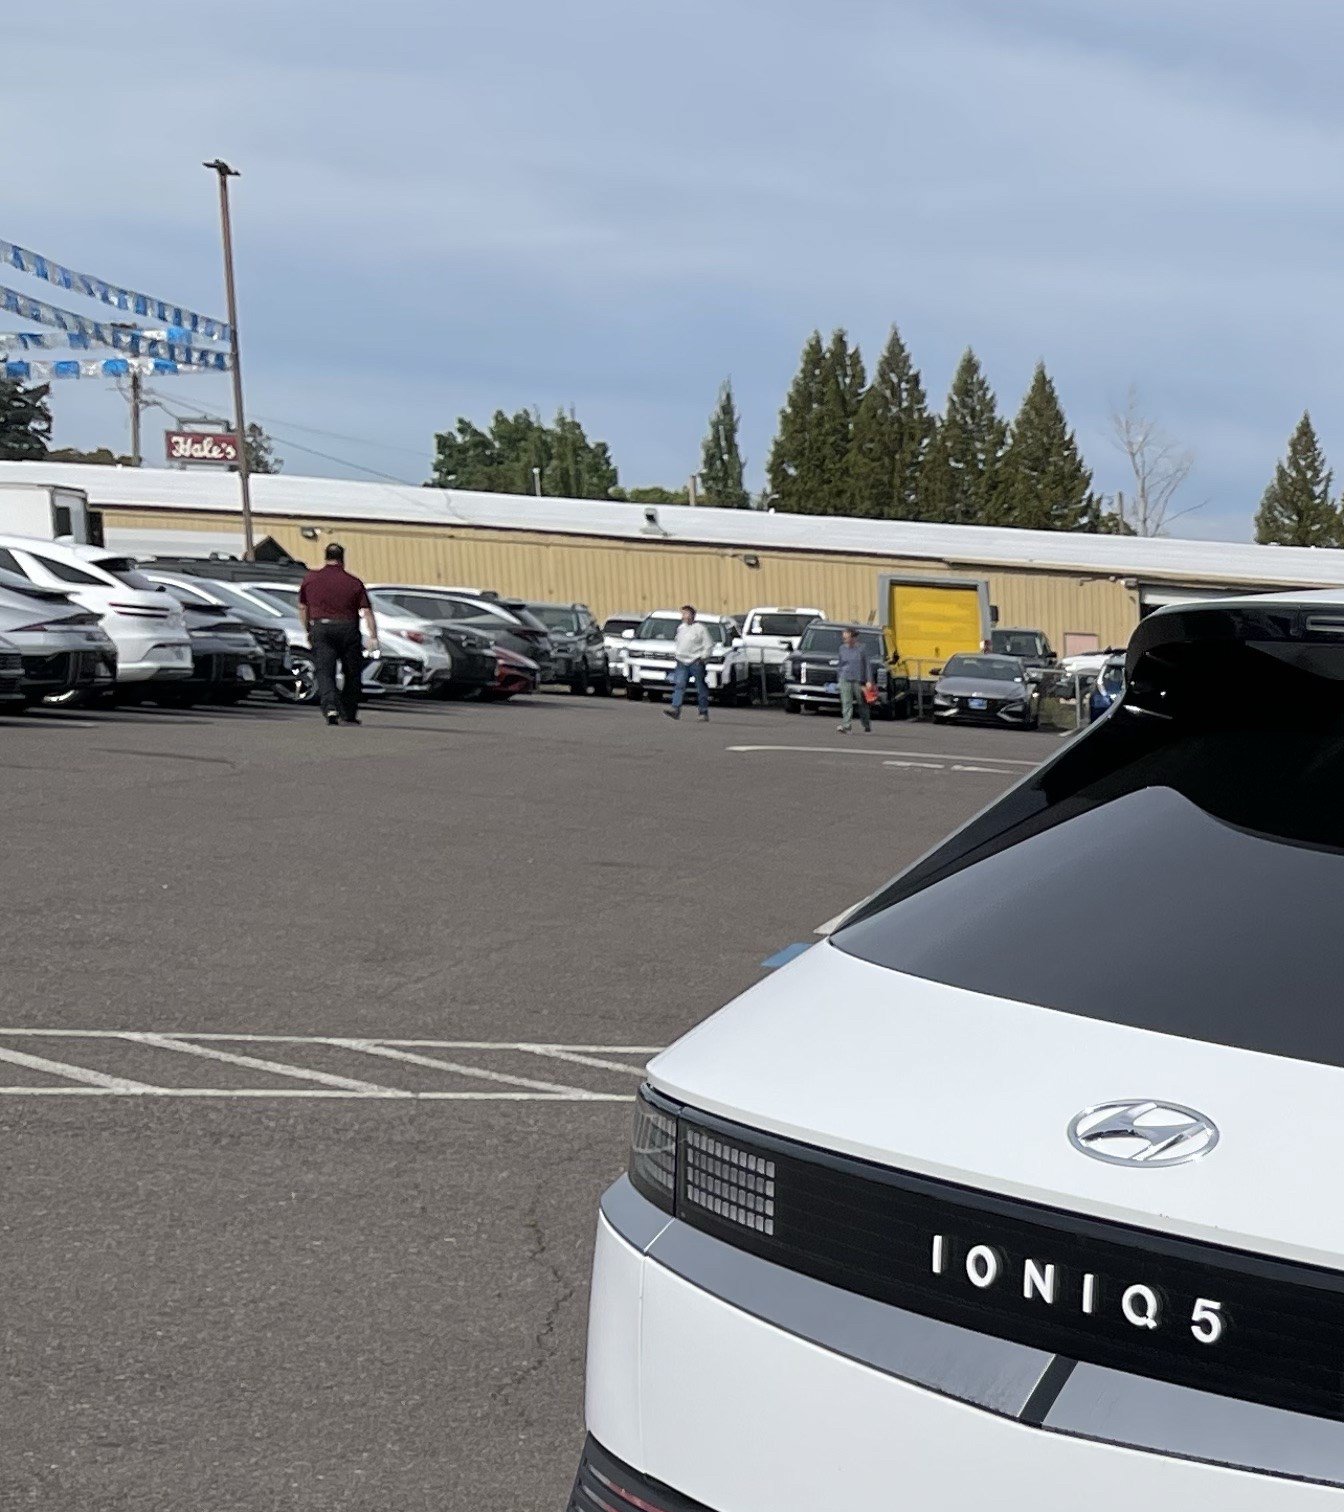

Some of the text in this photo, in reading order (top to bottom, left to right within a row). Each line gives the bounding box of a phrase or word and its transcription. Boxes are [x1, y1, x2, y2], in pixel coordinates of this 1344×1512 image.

[171, 436, 237, 459] Hale's
[931, 1234, 1225, 1344] IONIQ 5
